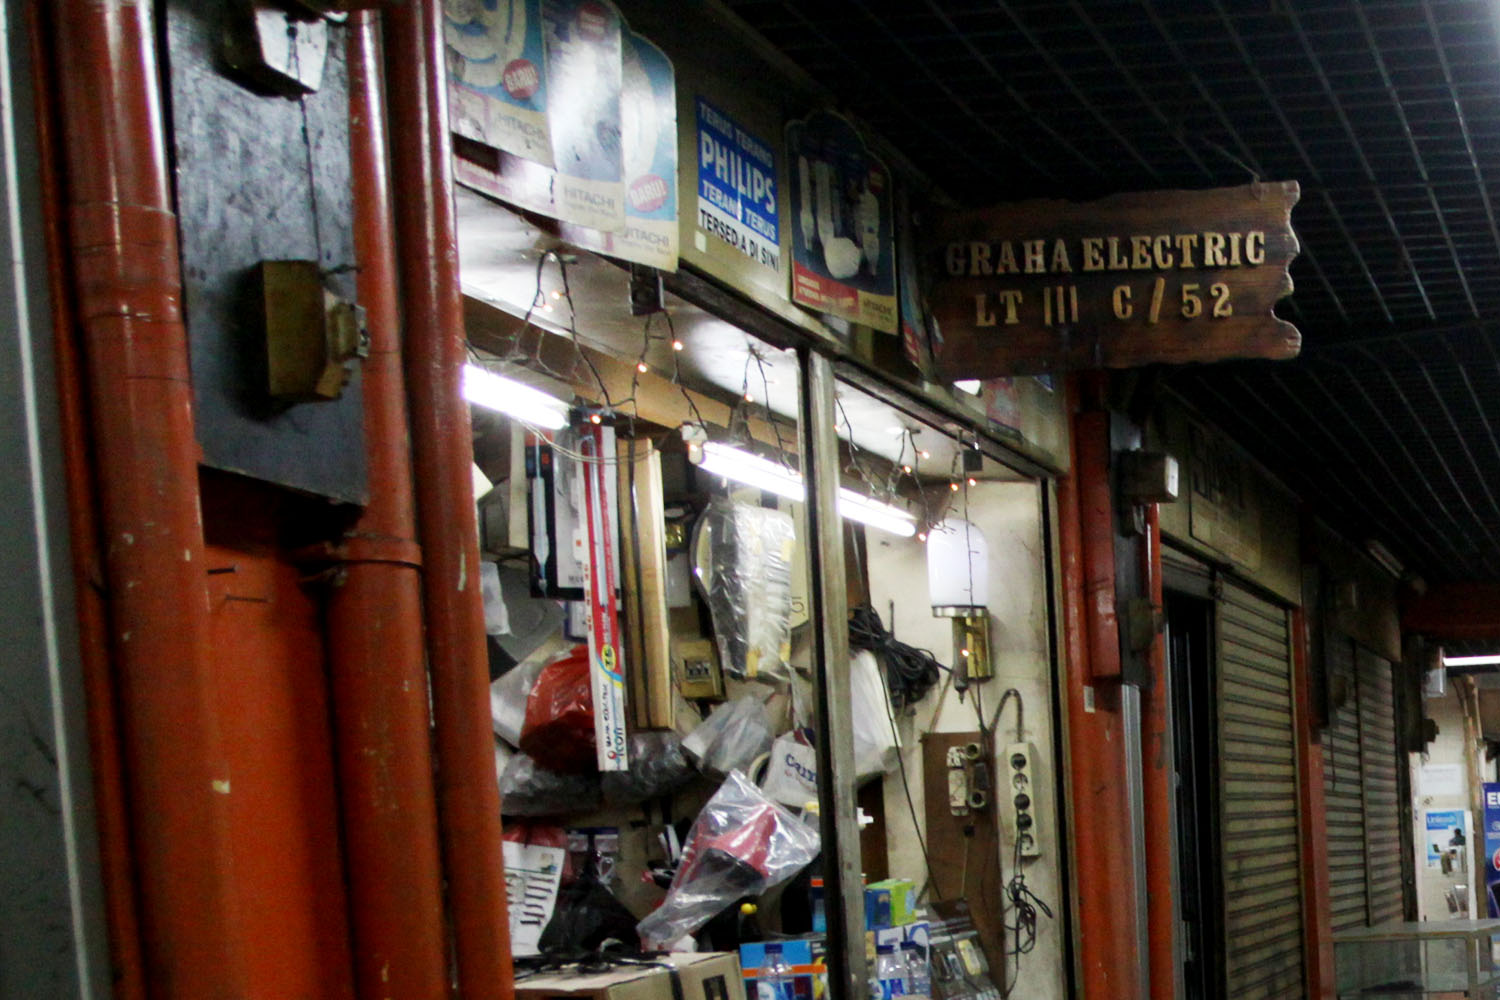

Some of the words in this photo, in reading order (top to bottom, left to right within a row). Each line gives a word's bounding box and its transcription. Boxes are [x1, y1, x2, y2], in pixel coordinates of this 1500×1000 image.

[700, 102, 733, 140] TERUS
[734, 127, 773, 169] TERANG
[700, 130, 776, 215] PHILIPS
[563, 186, 616, 210] HITACHI
[628, 179, 668, 207] BARU!
[745, 207, 776, 242] TERUS
[946, 237, 1073, 277] GRAHA
[1082, 230, 1267, 272] ELECTRIC
[975, 289, 1023, 328] LT
